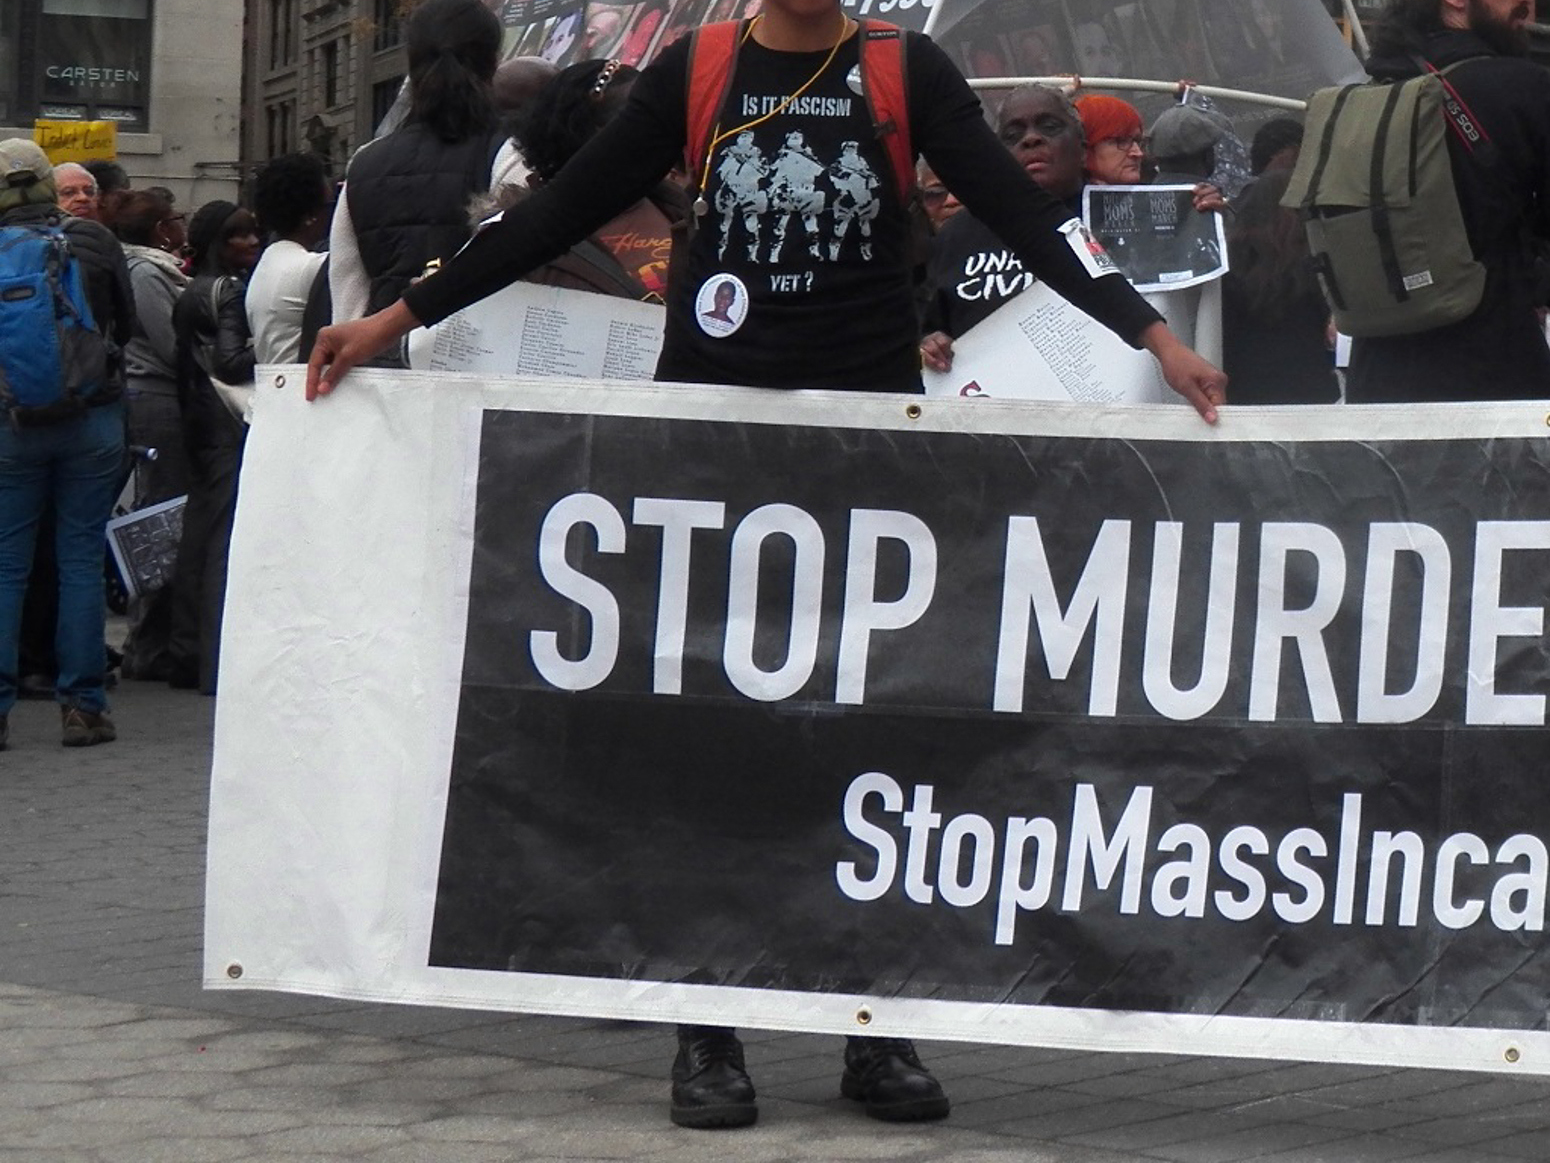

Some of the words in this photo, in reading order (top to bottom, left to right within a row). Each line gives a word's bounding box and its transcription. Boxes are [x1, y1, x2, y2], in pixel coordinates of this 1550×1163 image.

[46, 65, 140, 82] CARSTEN
[762, 96, 778, 115] IT
[780, 95, 852, 117] FASCISM
[1456, 113, 1480, 142] EOS
[769, 275, 801, 292] YET
[530, 492, 938, 705] STOP
